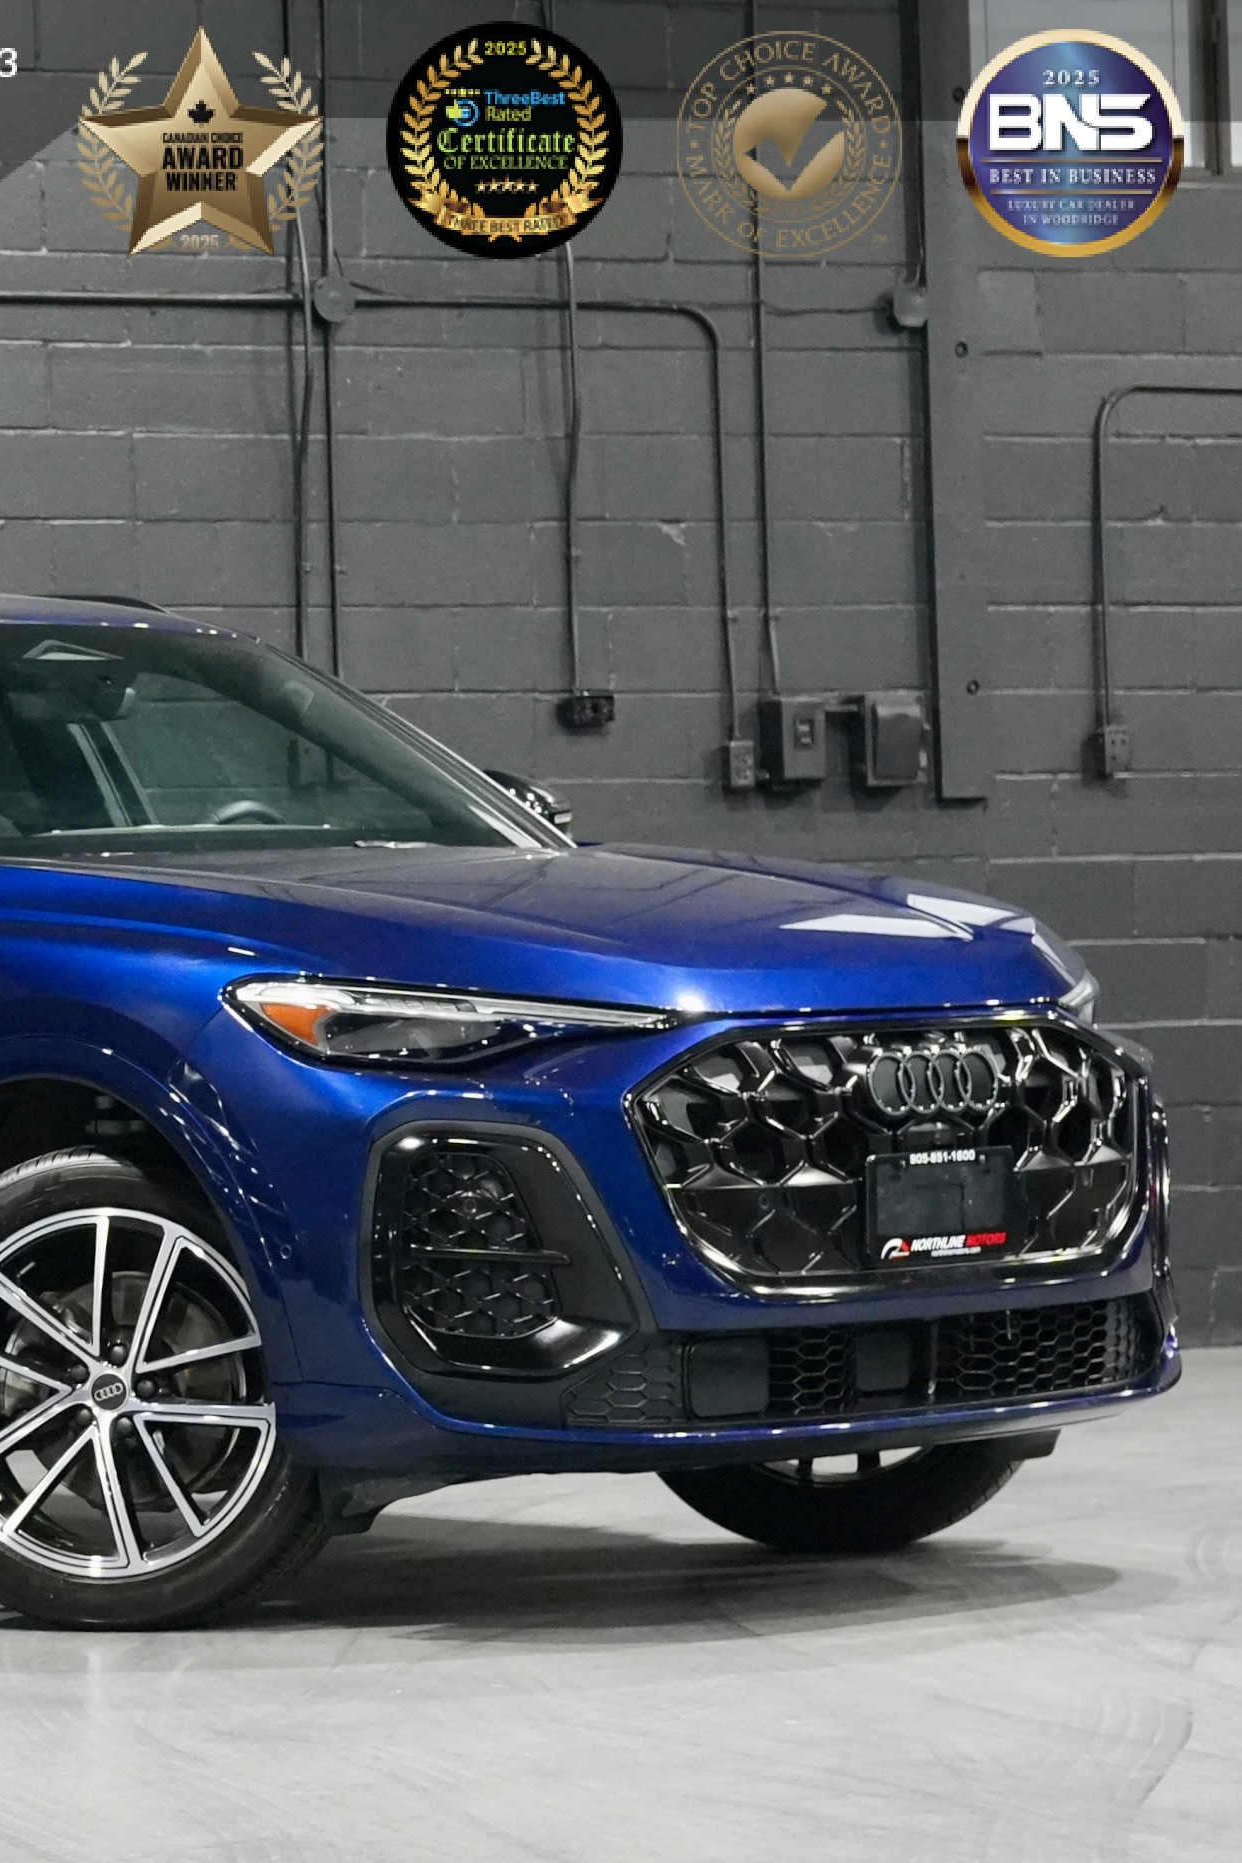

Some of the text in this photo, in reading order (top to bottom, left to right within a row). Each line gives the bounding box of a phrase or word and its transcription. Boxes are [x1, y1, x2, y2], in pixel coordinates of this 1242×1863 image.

[909, 1149, 976, 1165] 905-851-1600
[910, 1235, 966, 1252] NORTHLINE
[965, 1232, 1007, 1247] MOTORS
